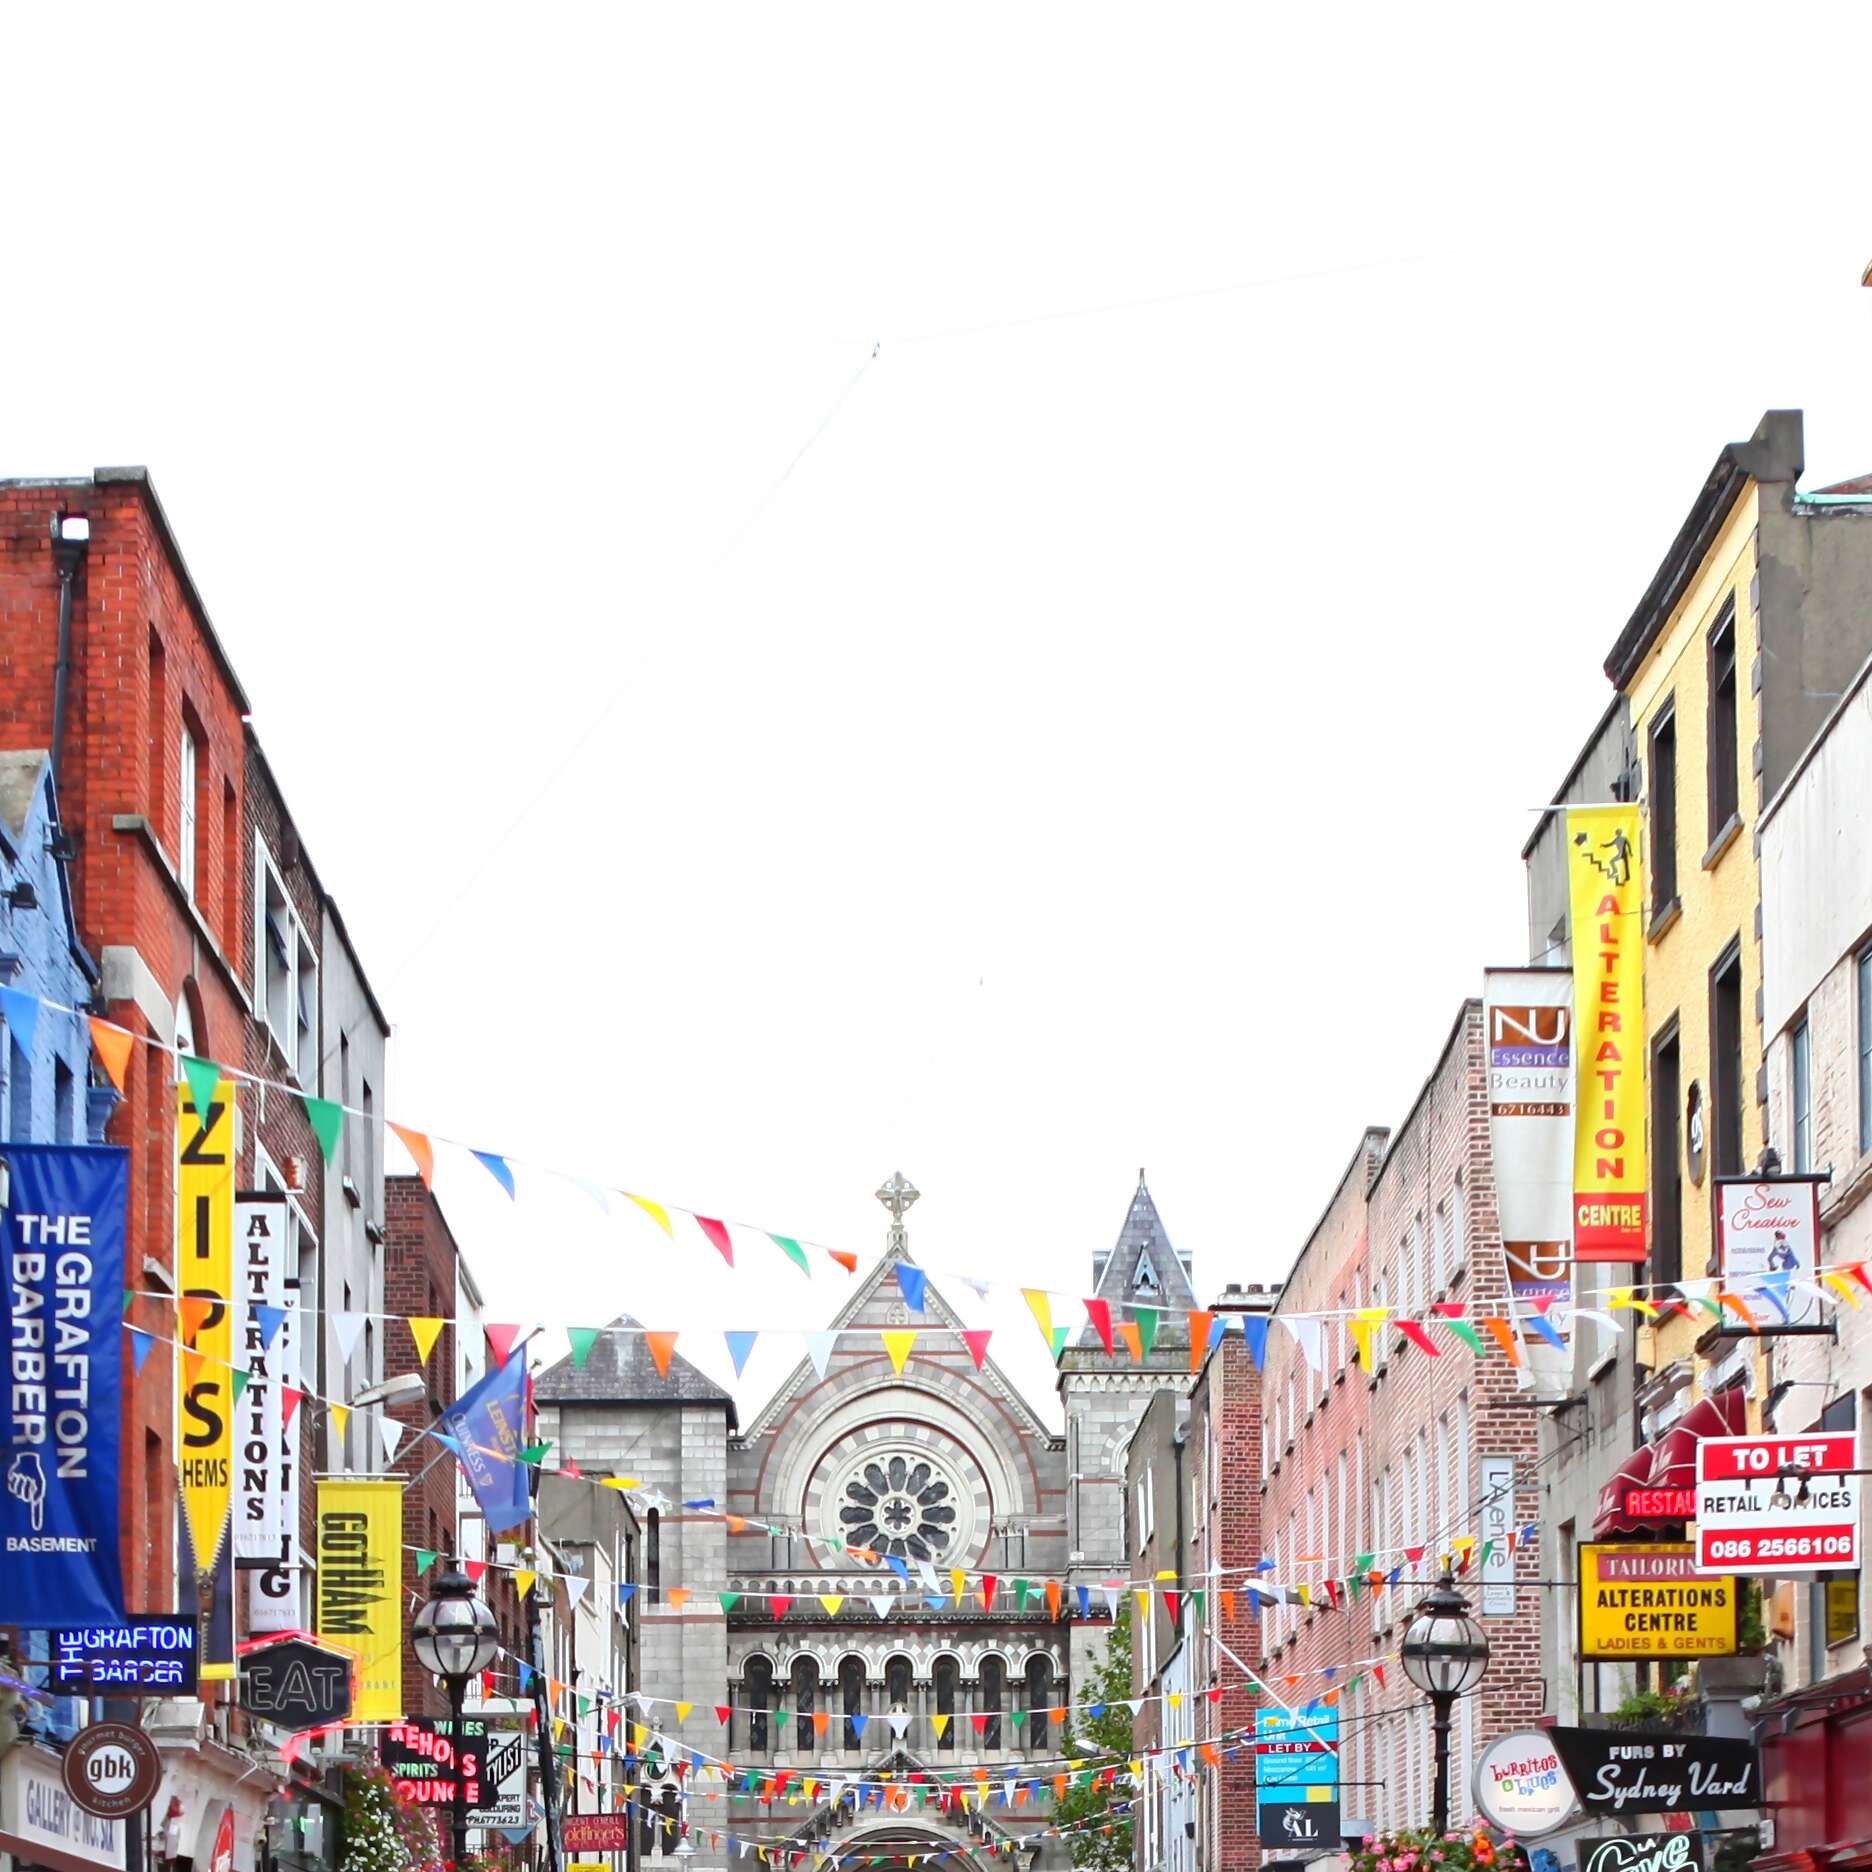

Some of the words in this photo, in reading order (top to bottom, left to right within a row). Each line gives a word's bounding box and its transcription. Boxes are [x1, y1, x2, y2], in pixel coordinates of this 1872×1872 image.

[1494, 1009, 1566, 1045] NU
[1595, 893, 1626, 1180] ALTERATION
[1491, 1048, 1570, 1067] Essence
[1490, 1072, 1568, 1092] Beauty
[1744, 1183, 1792, 1211] Sew
[1578, 1204, 1642, 1227] CENTRE
[1731, 1208, 1801, 1231] Creative
[15, 1214, 92, 1246] THE
[11, 1253, 48, 1446] BARBER
[54, 1252, 93, 1479] GRAFTON
[1732, 1447, 1770, 1471] TO
[1779, 1444, 1828, 1469] LET
[182, 1457, 228, 1488] HEMS
[1629, 1489, 1696, 1515] RESTAU
[1704, 1495, 1762, 1514] RETAIL
[6, 1537, 97, 1553] BASEMENT
[1710, 1539, 1752, 1559] 086
[1756, 1536, 1851, 1557] 2566106
[321, 1512, 392, 1635] GOTHAM
[1606, 1558, 1696, 1577] TAILORIN
[1597, 1588, 1726, 1608] ALTERATIONS
[1624, 1612, 1698, 1631] CENTRE
[84, 1626, 193, 1649] GRAFTON
[1597, 1636, 1651, 1650] LADIES
[1657, 1637, 1666, 1649] &
[1673, 1636, 1726, 1649] GENTS
[60, 1631, 83, 1682] THE
[248, 1660, 343, 1713] EAT
[434, 1720, 485, 1737] WIES
[1268, 1743, 1290, 1754] LET
[1294, 1742, 1312, 1753] BY
[1609, 1745, 1655, 1760] FURS
[1663, 1743, 1687, 1758] BY
[89, 1754, 132, 1783] gbk
[392, 1762, 439, 1777] SPIRITS
[486, 1740, 521, 1786] TYLIST
[1587, 1763, 1682, 1809] Sydney
[1687, 1761, 1752, 1795] Vard
[1637, 1837, 1656, 1851] LA
